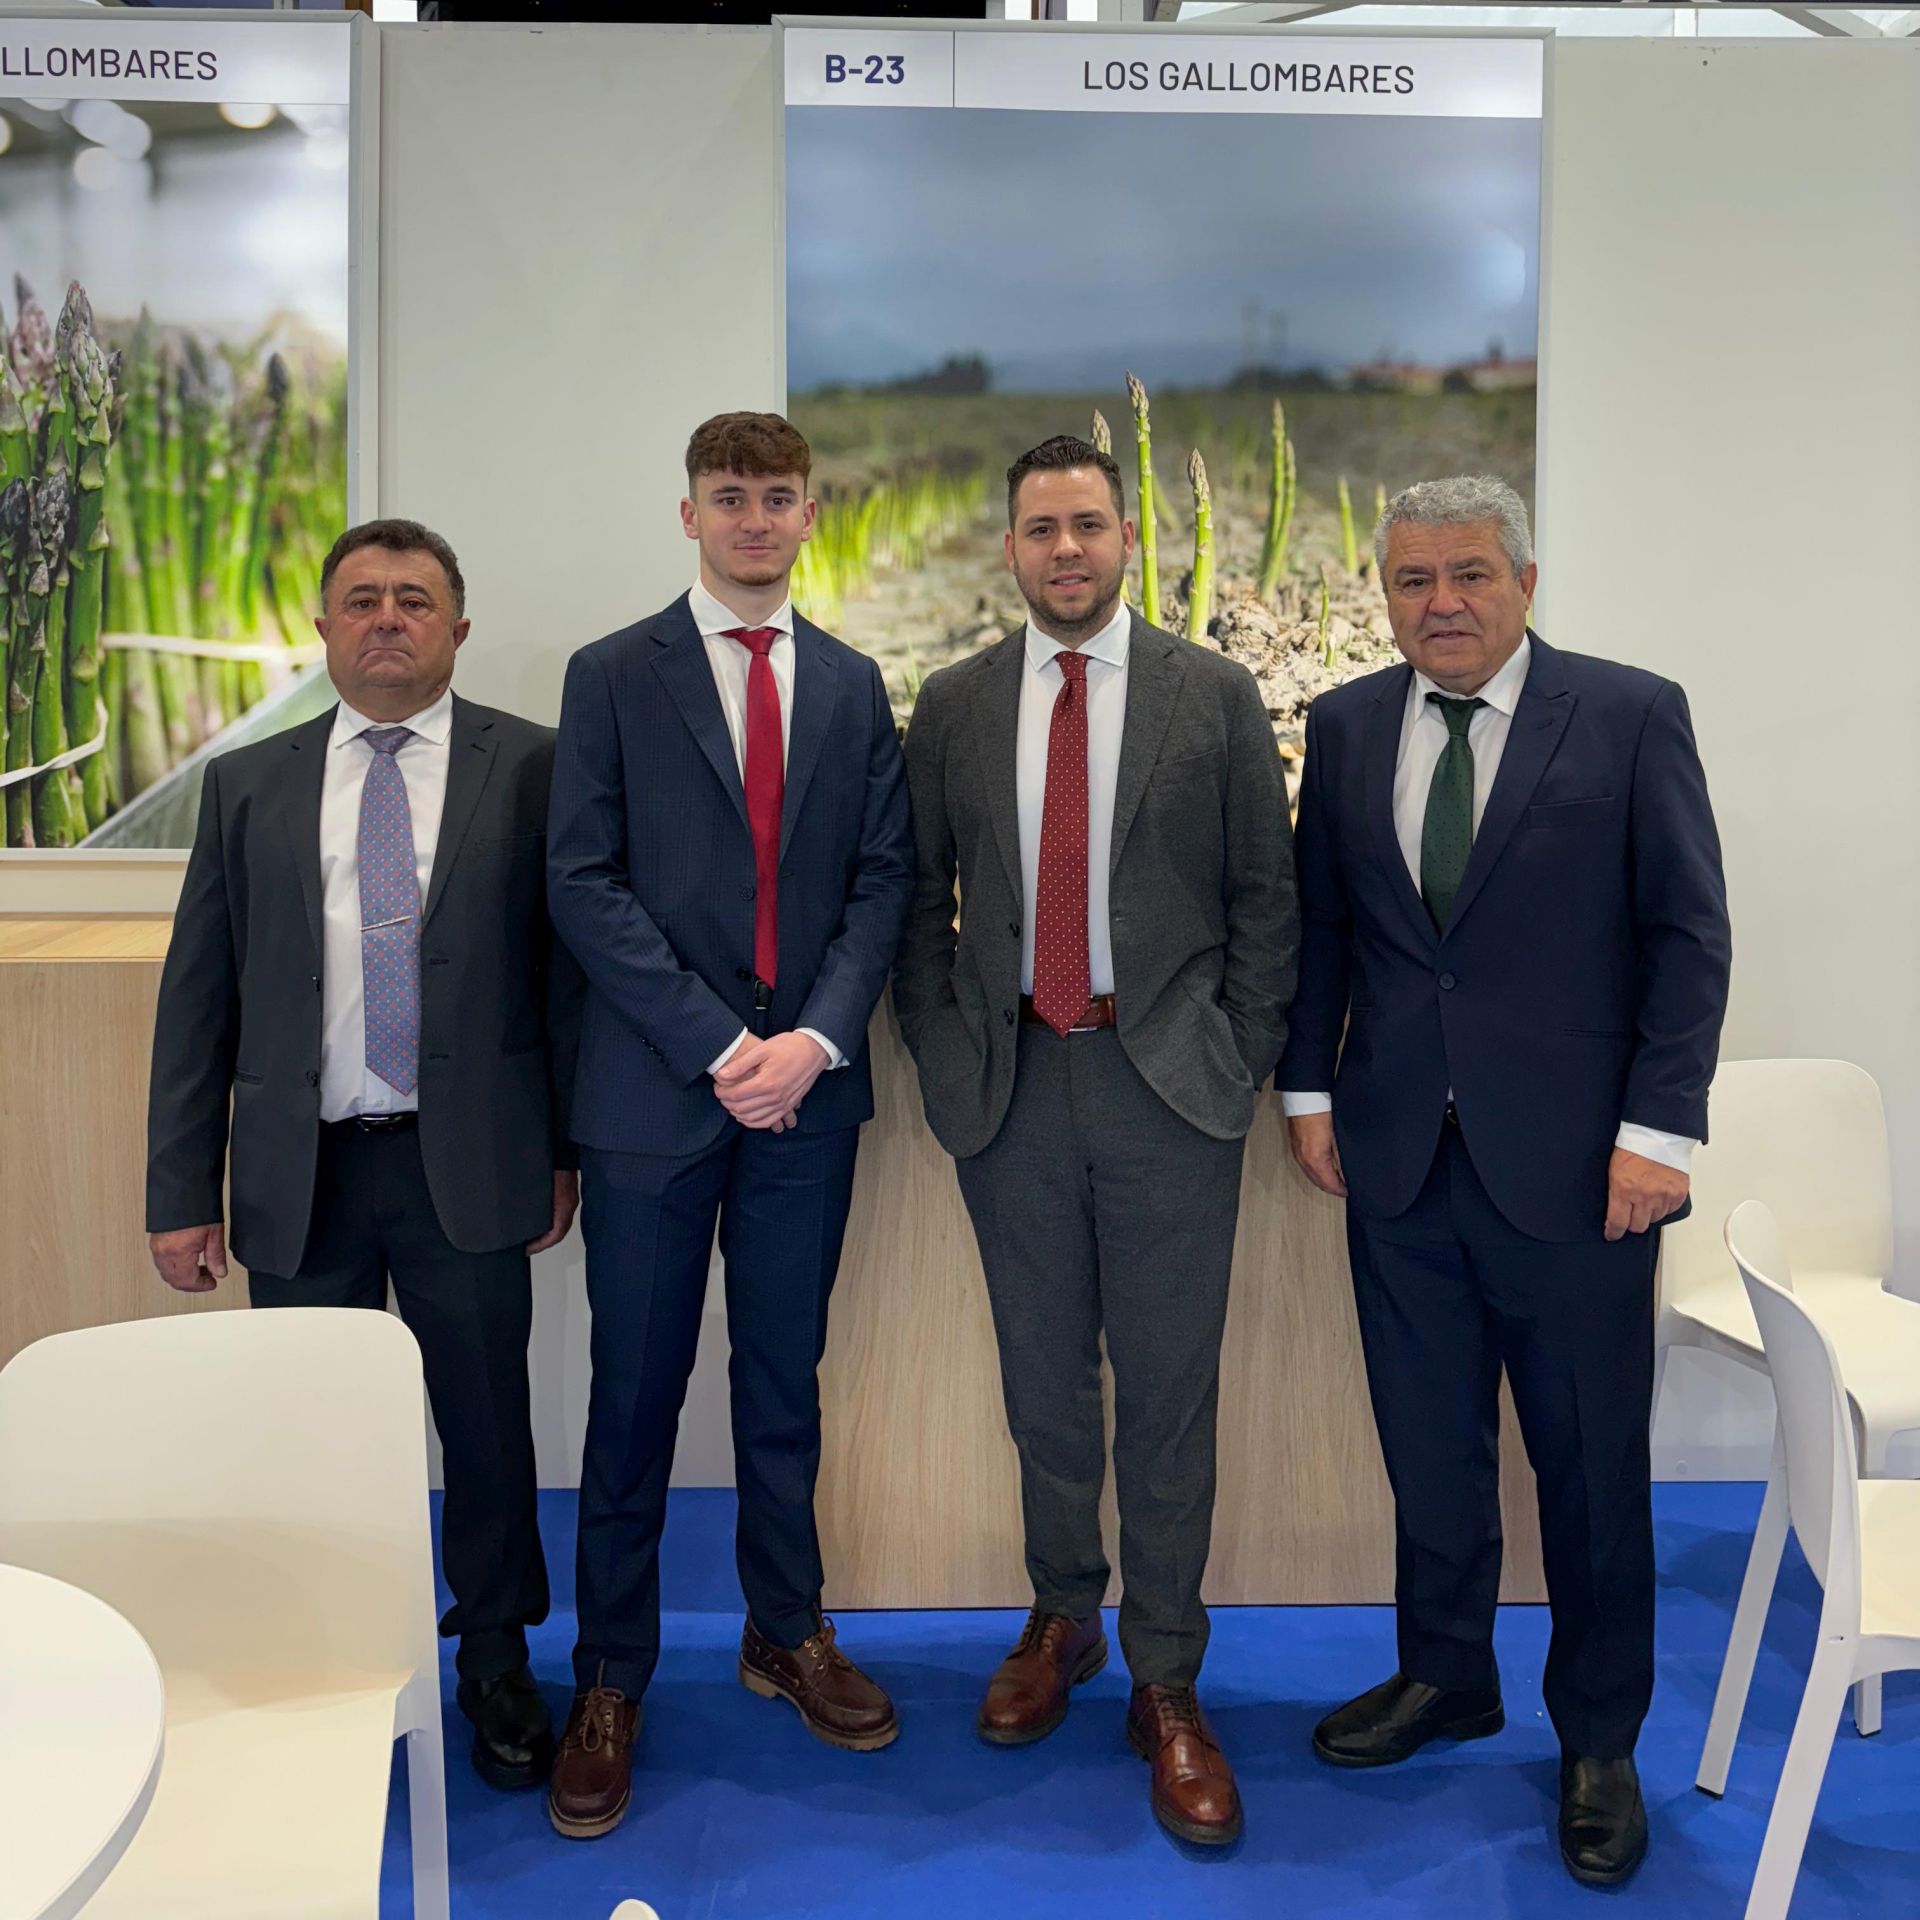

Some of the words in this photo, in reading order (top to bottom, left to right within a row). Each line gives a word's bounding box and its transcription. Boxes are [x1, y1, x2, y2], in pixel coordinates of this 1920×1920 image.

[825, 54, 905, 85] B-23
[1084, 60, 1149, 91] LOS
[1159, 61, 1414, 94] GALLOMBARES
